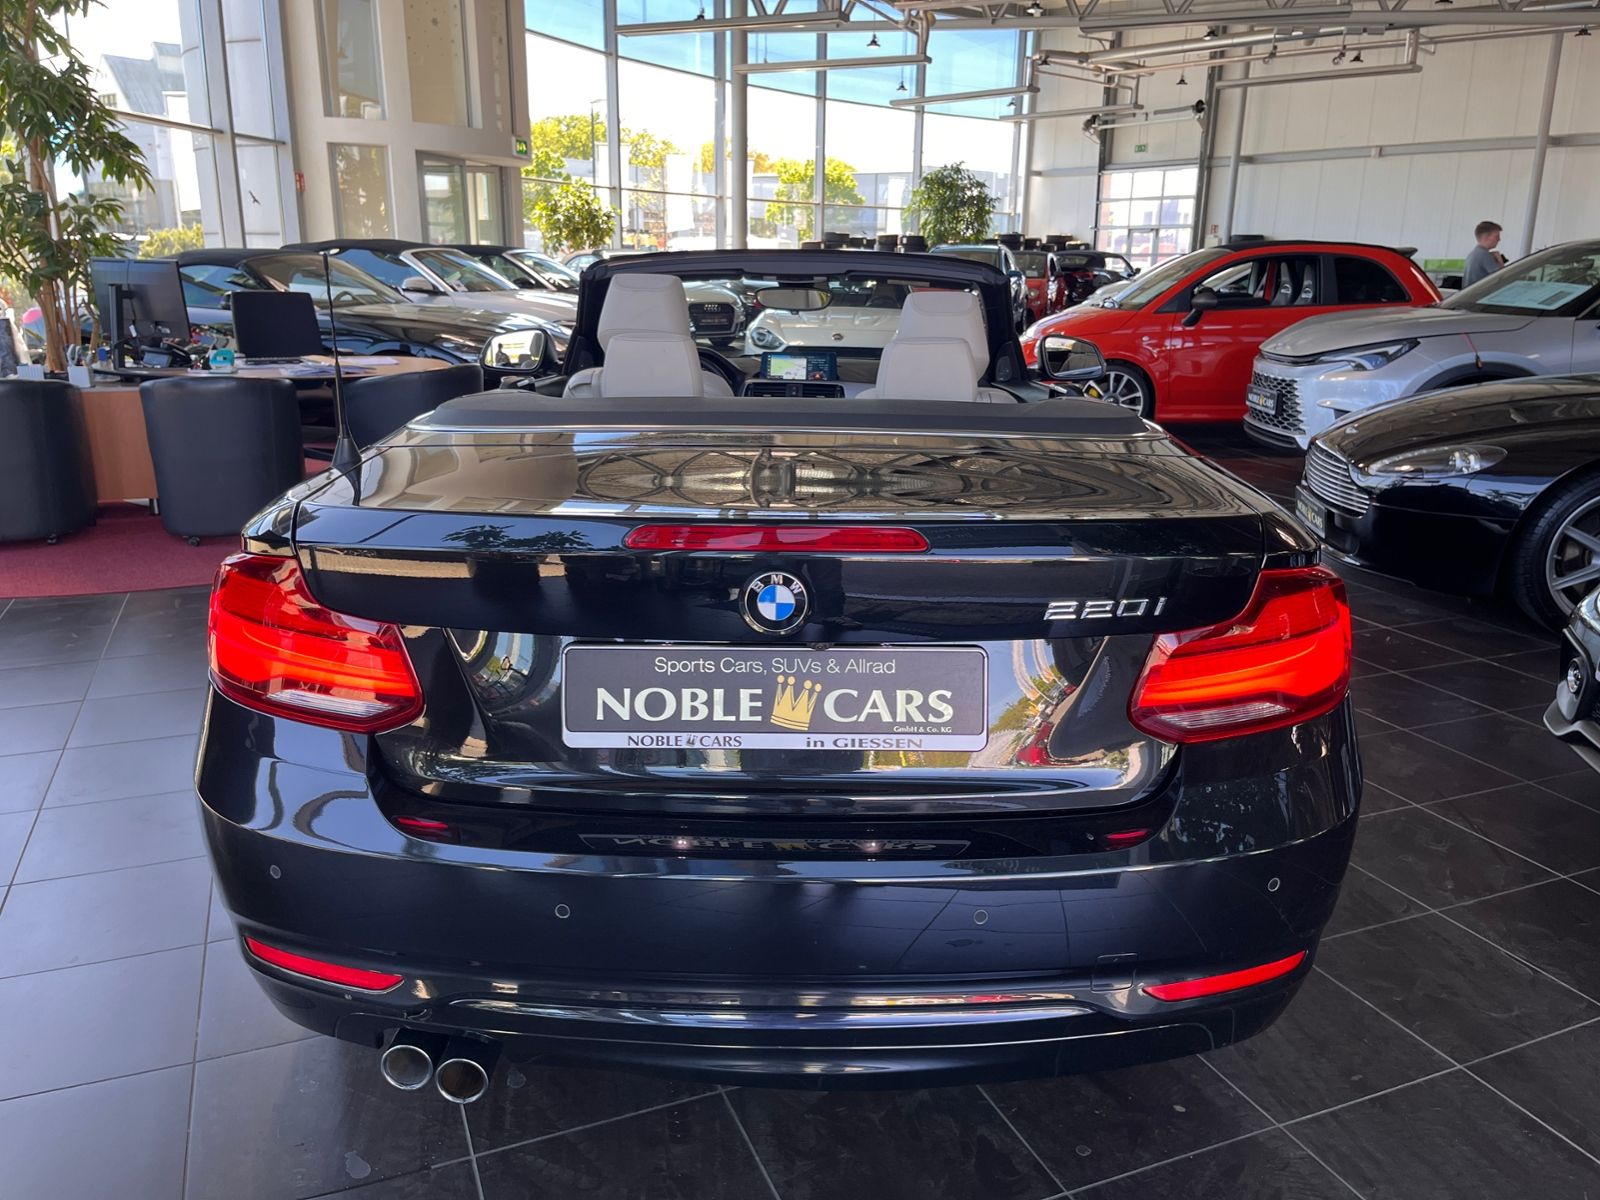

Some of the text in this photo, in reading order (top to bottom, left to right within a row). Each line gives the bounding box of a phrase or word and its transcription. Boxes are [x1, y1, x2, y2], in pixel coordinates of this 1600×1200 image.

[751, 574, 802, 593] BMW
[1043, 597, 1167, 620] 220i
[654, 656, 896, 676] Sports Cars, SUVs & Allrad
[596, 687, 954, 723] NOBLE CARS
[893, 725, 918, 733] GmbH
[918, 725, 925, 733] &
[627, 735, 742, 747] NOBLE CARS
[806, 737, 923, 748] in GIESSEN
